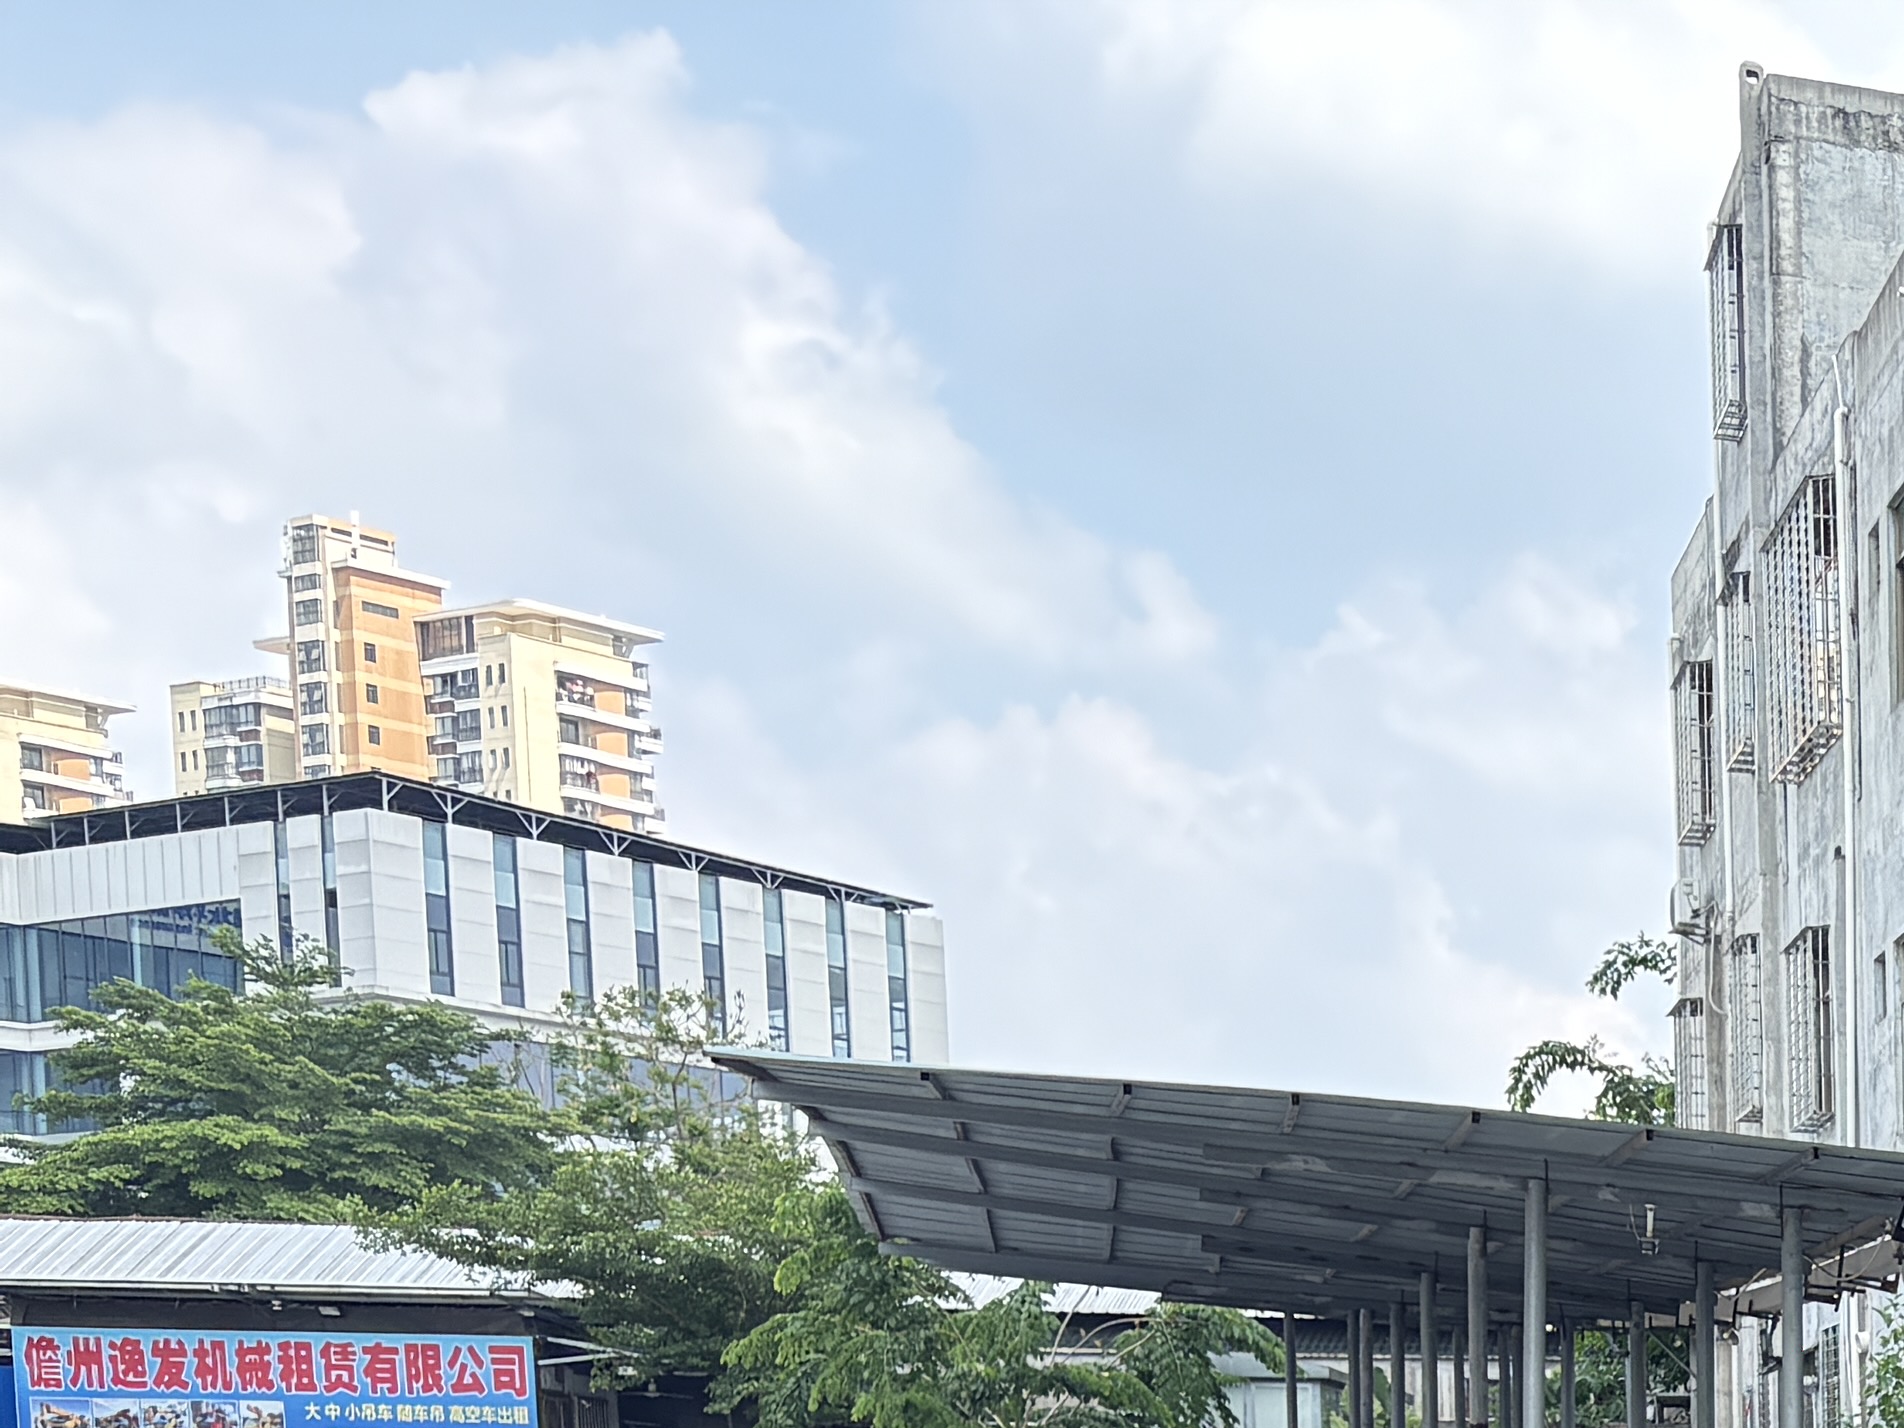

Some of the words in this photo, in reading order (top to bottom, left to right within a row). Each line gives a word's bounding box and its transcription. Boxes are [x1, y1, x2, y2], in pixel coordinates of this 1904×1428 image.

[24, 1336, 528, 1398] 儋州逸发机械租赁有限公司
